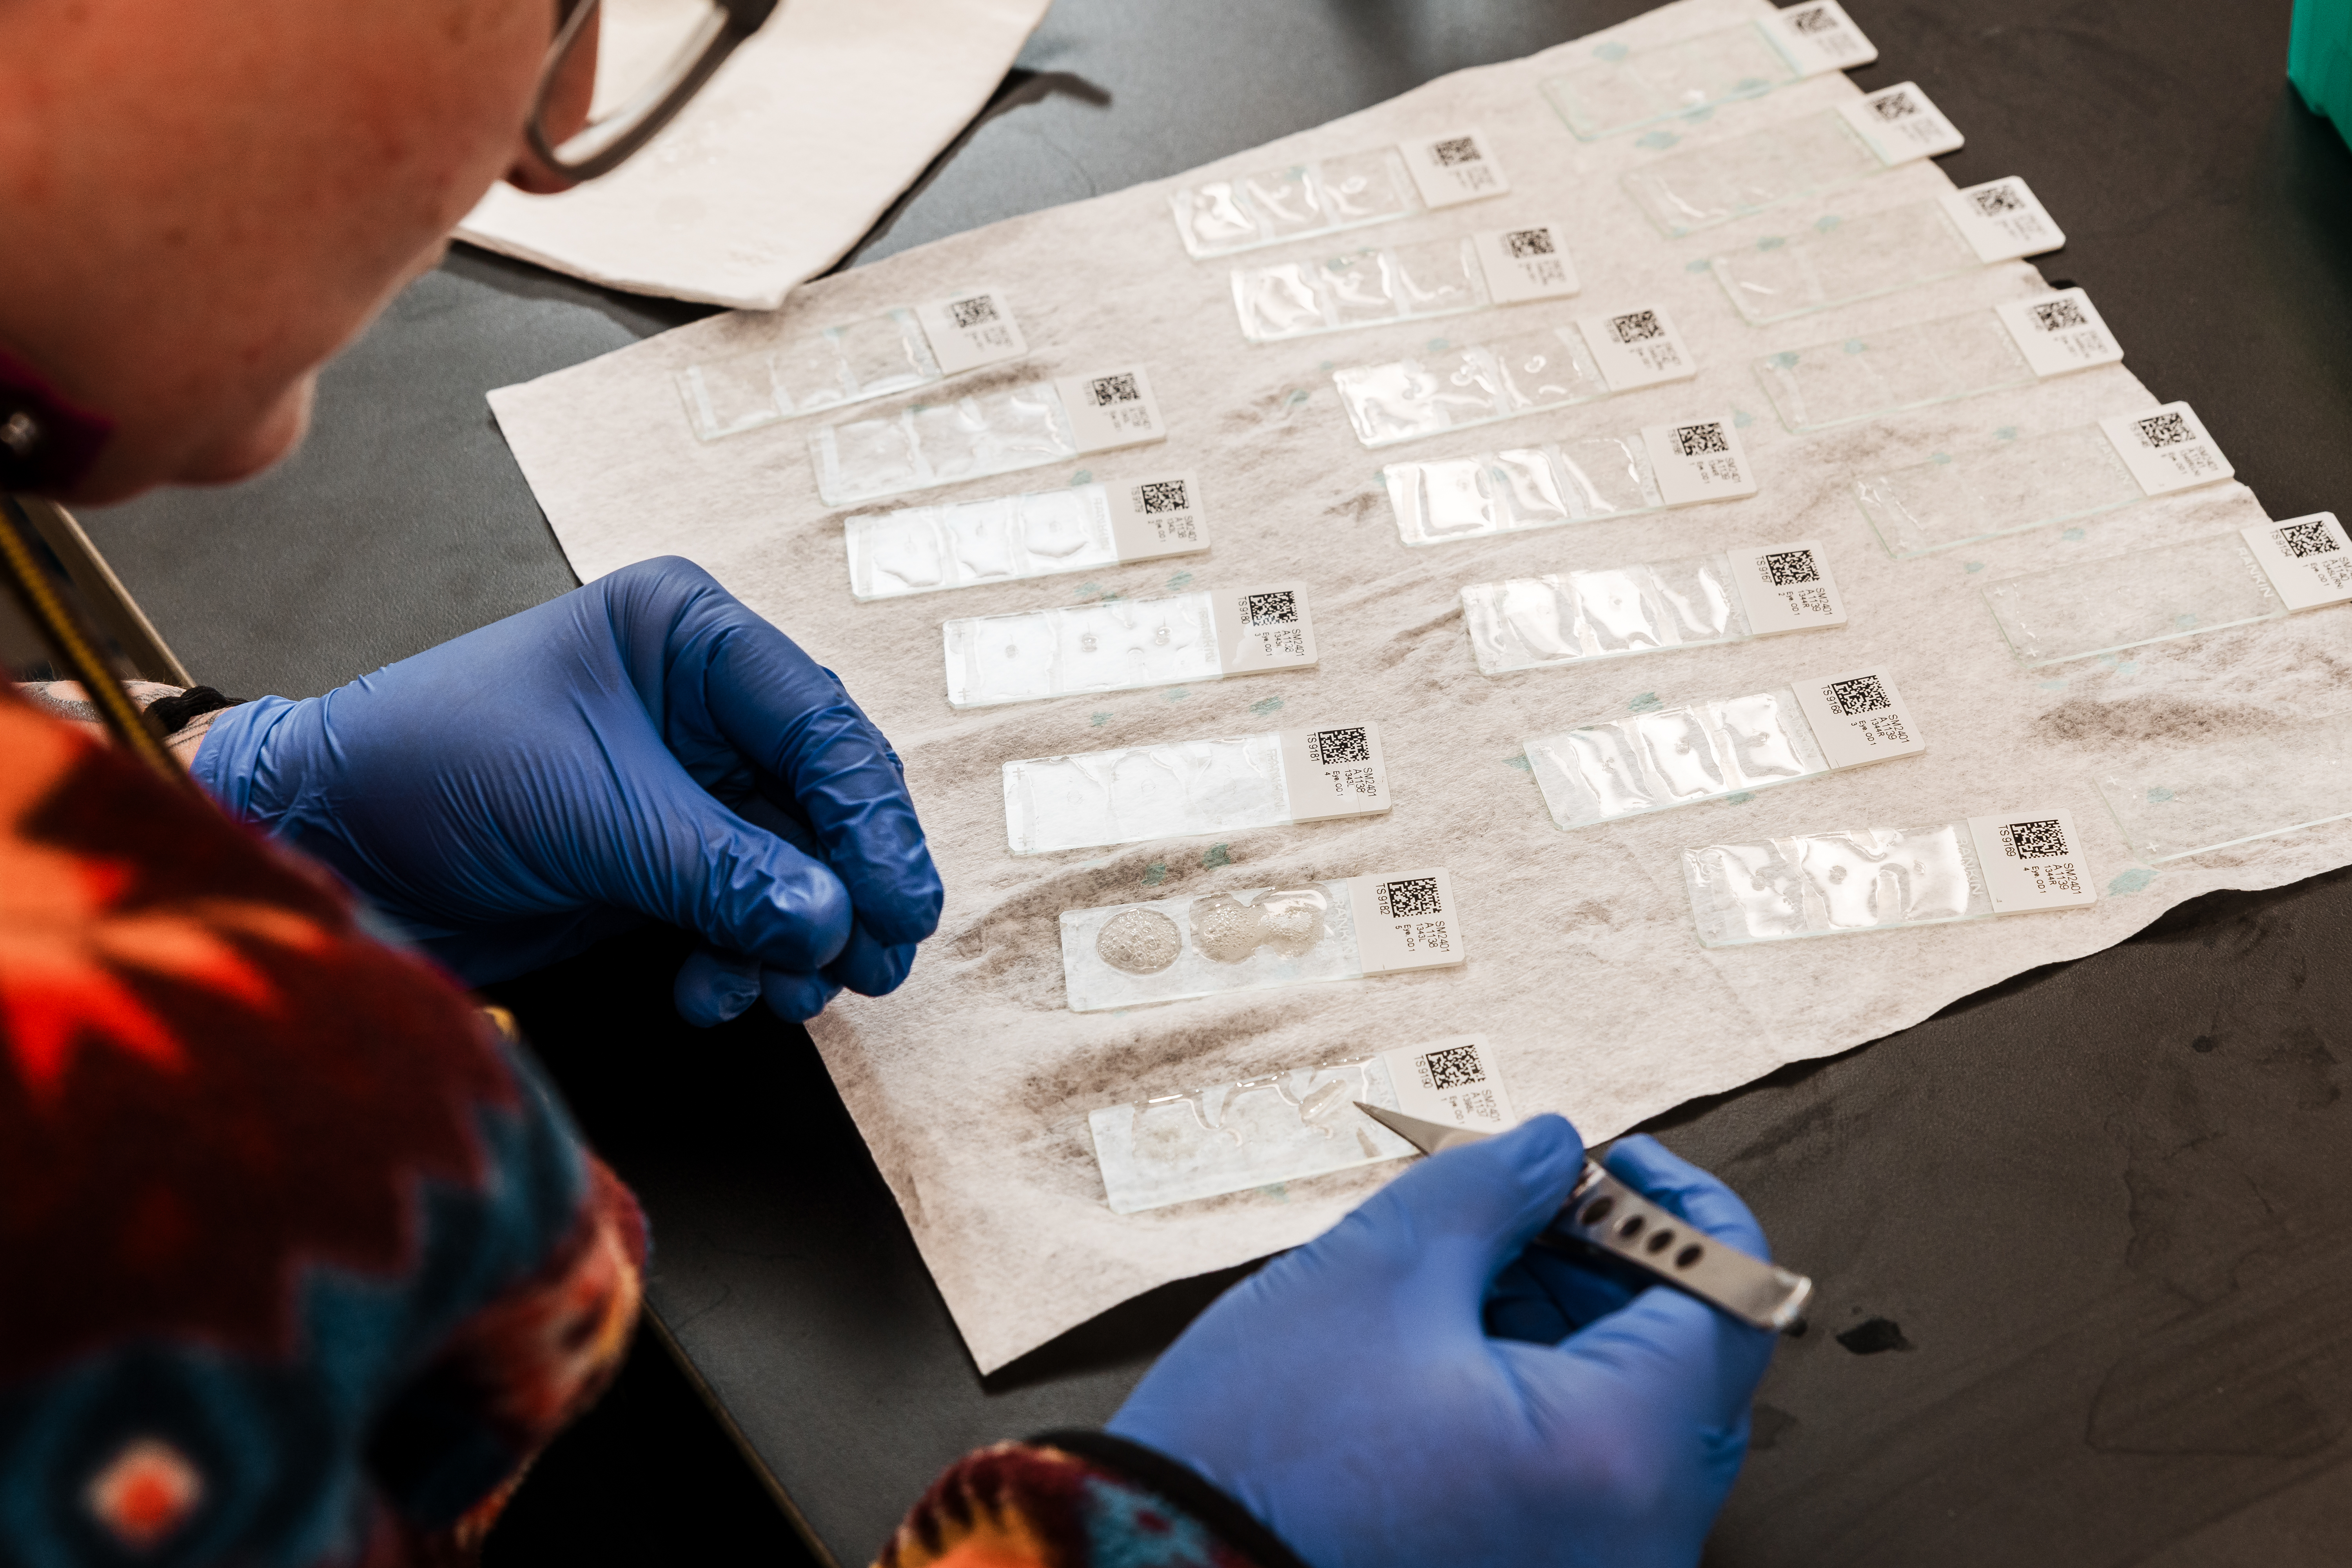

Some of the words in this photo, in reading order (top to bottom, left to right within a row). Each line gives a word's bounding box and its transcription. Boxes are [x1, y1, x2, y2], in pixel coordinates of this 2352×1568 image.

[1798, 590, 1810, 608] 1344R
[1815, 588, 1833, 615] SM2401
[1292, 629, 1305, 656] SM2401
[1821, 684, 1833, 696] TS
[1826, 695, 1842, 714] 9168
[1858, 720, 1867, 732] Eye,
[1865, 732, 1875, 742] OD
[1870, 718, 1885, 737] 1344R
[1882, 723, 1897, 740] 1139
[1888, 714, 1910, 743] SM2401
[1307, 732, 1317, 743] TS
[1308, 744, 1320, 761] 9181
[1332, 771, 1340, 782] Eye,
[1345, 769, 1354, 788] 1343L
[1354, 775, 1366, 793] 1138
[1363, 767, 1377, 797] SM2401
[1335, 783, 1343, 792] OD
[1998, 824, 2010, 836] TS
[2002, 837, 2016, 857] 9169
[2031, 866, 2040, 878] Eye,
[2036, 879, 2045, 889] OD
[2044, 865, 2057, 885] 1344R
[2055, 871, 2069, 890] 1139
[2063, 863, 2082, 894] SM2401
[1376, 883, 1387, 895] TS
[1378, 896, 1390, 915] 9182
[1403, 924, 1411, 936] Eye,
[1416, 923, 1426, 942] 1343L
[1426, 929, 1439, 948] 1138
[1435, 921, 1450, 952] SM2401
[1406, 938, 1415, 947] OD
